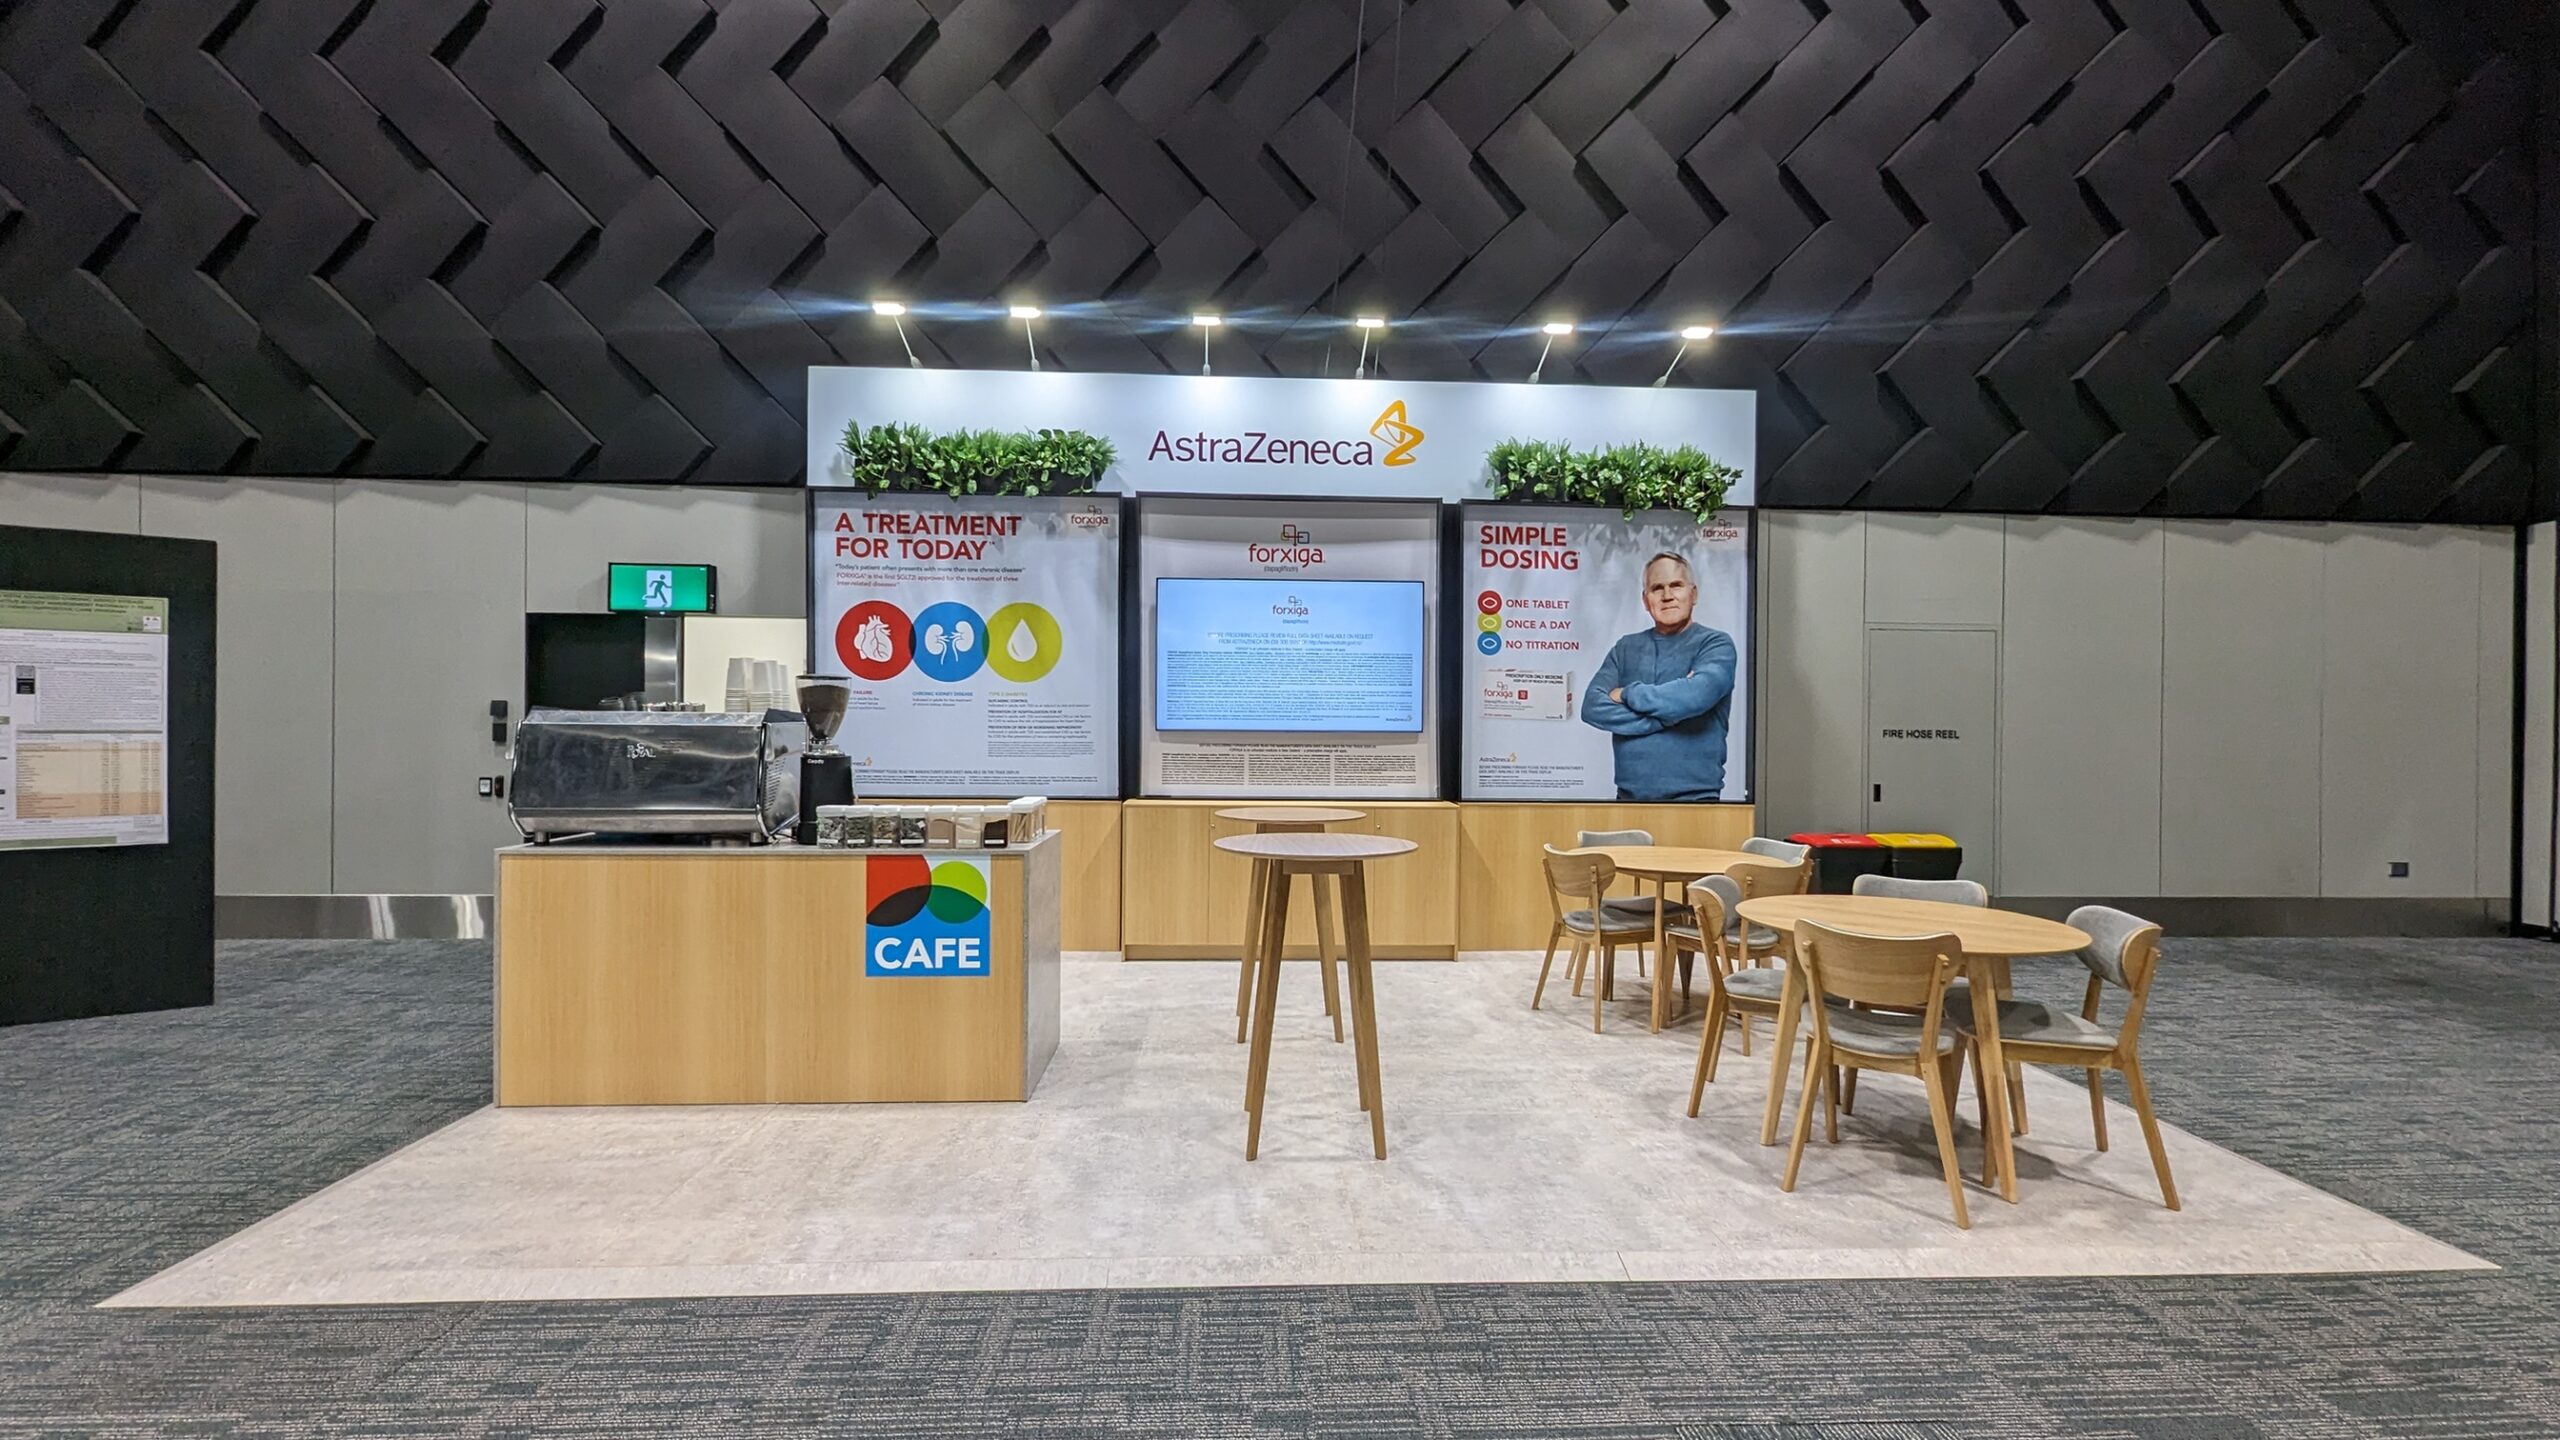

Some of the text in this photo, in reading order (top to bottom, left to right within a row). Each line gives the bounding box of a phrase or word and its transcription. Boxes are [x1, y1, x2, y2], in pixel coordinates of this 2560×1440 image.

[1148, 429, 1373, 466] AstraZeneca
[835, 512, 1022, 536] A TREATMENT
[1071, 513, 1109, 526] forxiga
[1480, 525, 1567, 546] SIMPLE
[1703, 527, 1738, 540] forxiga
[836, 537, 889, 558] FOR
[1248, 543, 1324, 568] forxiga
[1481, 549, 1579, 570] DOSING
[1506, 599, 1570, 609] ONE TABLET
[1272, 605, 1309, 617] forxiga
[1506, 620, 1571, 629] ONCE A DAY
[1505, 640, 1580, 650] NO TITRATION
[1483, 688, 1513, 699] forxiga
[1882, 729, 1960, 739] FIRE HOSE REEL
[874, 937, 981, 970] CAFE
